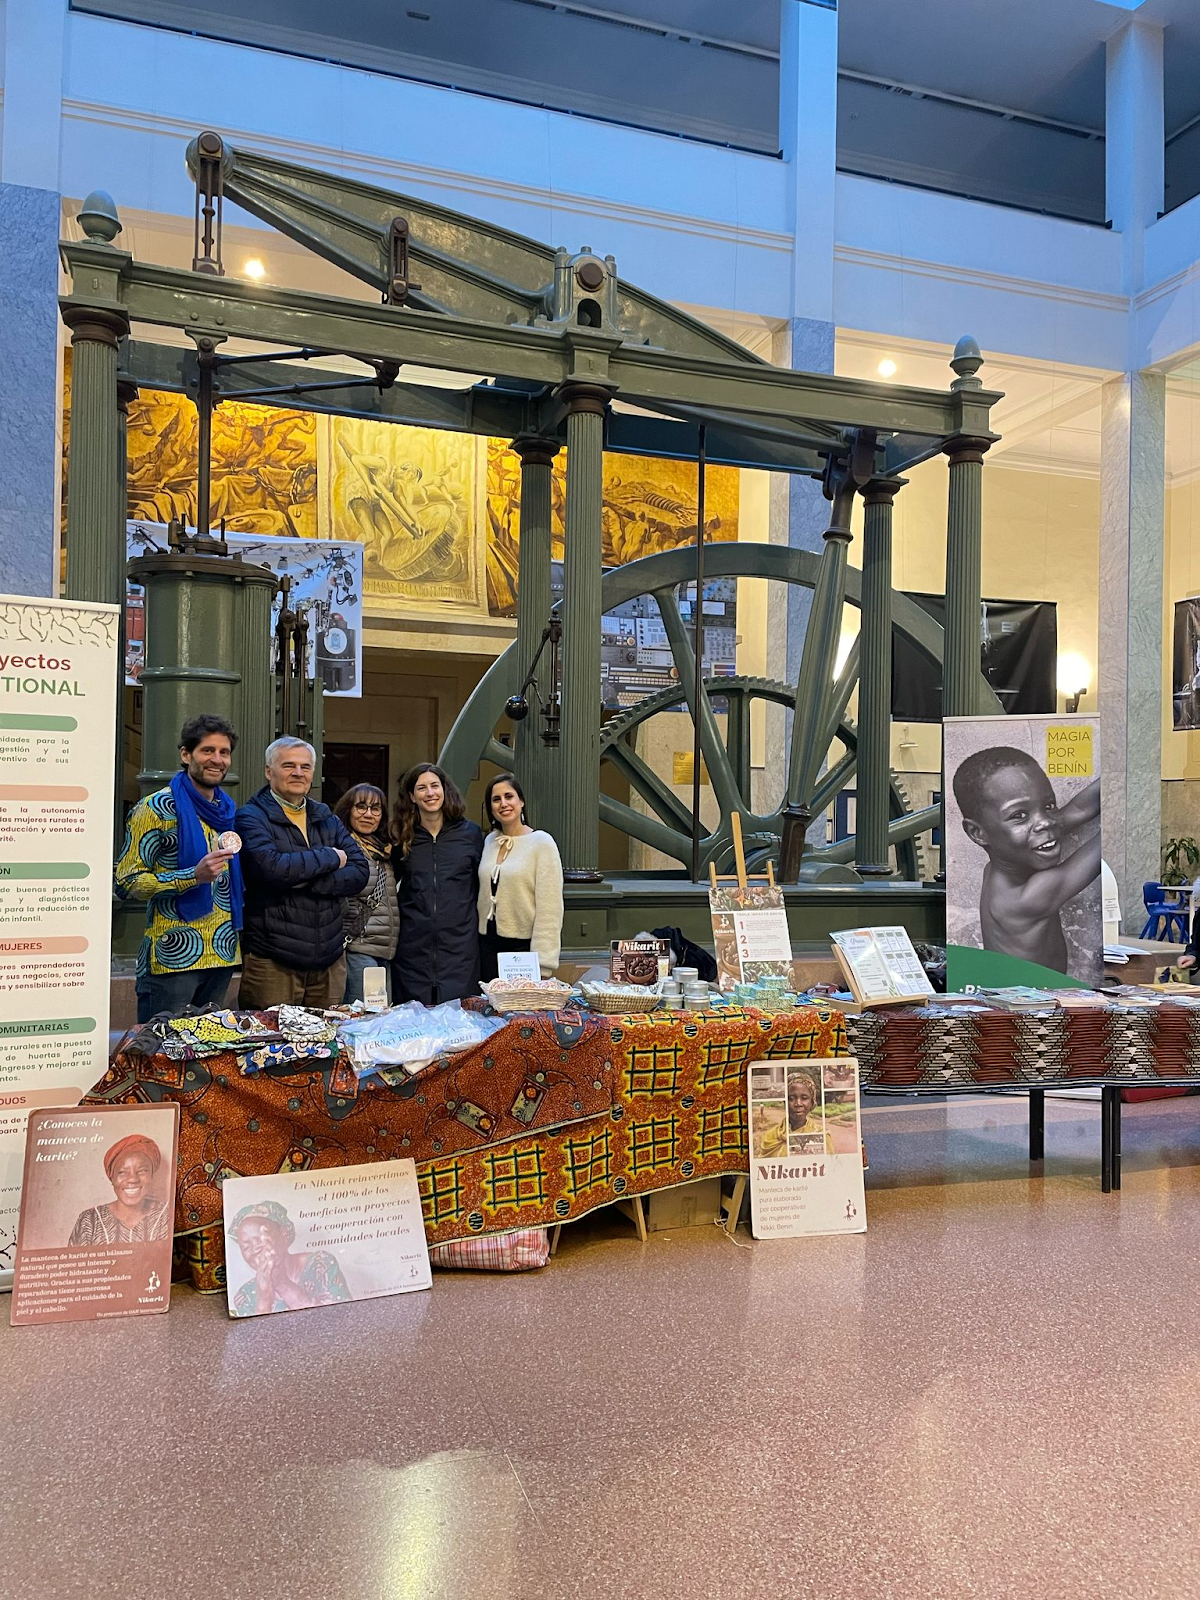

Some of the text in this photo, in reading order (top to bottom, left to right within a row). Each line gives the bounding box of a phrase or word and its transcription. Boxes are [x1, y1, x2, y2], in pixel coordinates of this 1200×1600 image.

[1, 676, 85, 697] TIONAL
[1048, 731, 1090, 741] MAGIA
[1048, 747, 1075, 757] POR
[1048, 761, 1087, 774] BENÍN
[14, 816, 47, 824] mujeres
[52, 886, 90, 894] prácticas
[39, 895, 90, 903] diagnósticos
[4, 906, 24, 914] para
[739, 921, 744, 929] 1
[740, 935, 747, 944] 2
[622, 941, 660, 951] Nikarit
[742, 949, 749, 958] 3
[21, 962, 85, 971] emprendedoras
[8, 983, 13, 991] y
[15, 981, 60, 989] sensibilizar
[10, 1043, 40, 1051] rurales
[63, 1040, 92, 1049] puesta
[72, 1050, 92, 1058] para
[46, 1060, 80, 1069] mejorar
[37, 1118, 88, 1131] ¿Conoces
[91, 1117, 103, 1127] la
[36, 1133, 104, 1146] manteca de
[35, 1150, 78, 1162] karité?
[757, 1163, 826, 1181] Nikarit
[294, 1170, 410, 1190] En Nikarit reinvertimos
[318, 1186, 389, 1201] el 100% de los
[759, 1186, 783, 1194] Manteca
[773, 1195, 802, 1203] elaborada
[299, 1199, 411, 1219] beneficios en proyectos
[770, 1204, 806, 1213] cooperativas
[309, 1214, 403, 1232] de cooperación con
[769, 1214, 792, 1223] mujeres
[306, 1226, 411, 1248] comunidades locales
[50, 1279, 75, 1287] Gracias
[93, 1275, 131, 1284] propiedades
[18, 1290, 57, 1298] reparadoras
[17, 1298, 57, 1307] aplicaciones
[137, 1296, 164, 1304] Nikarit
[16, 1308, 29, 1316] piel
